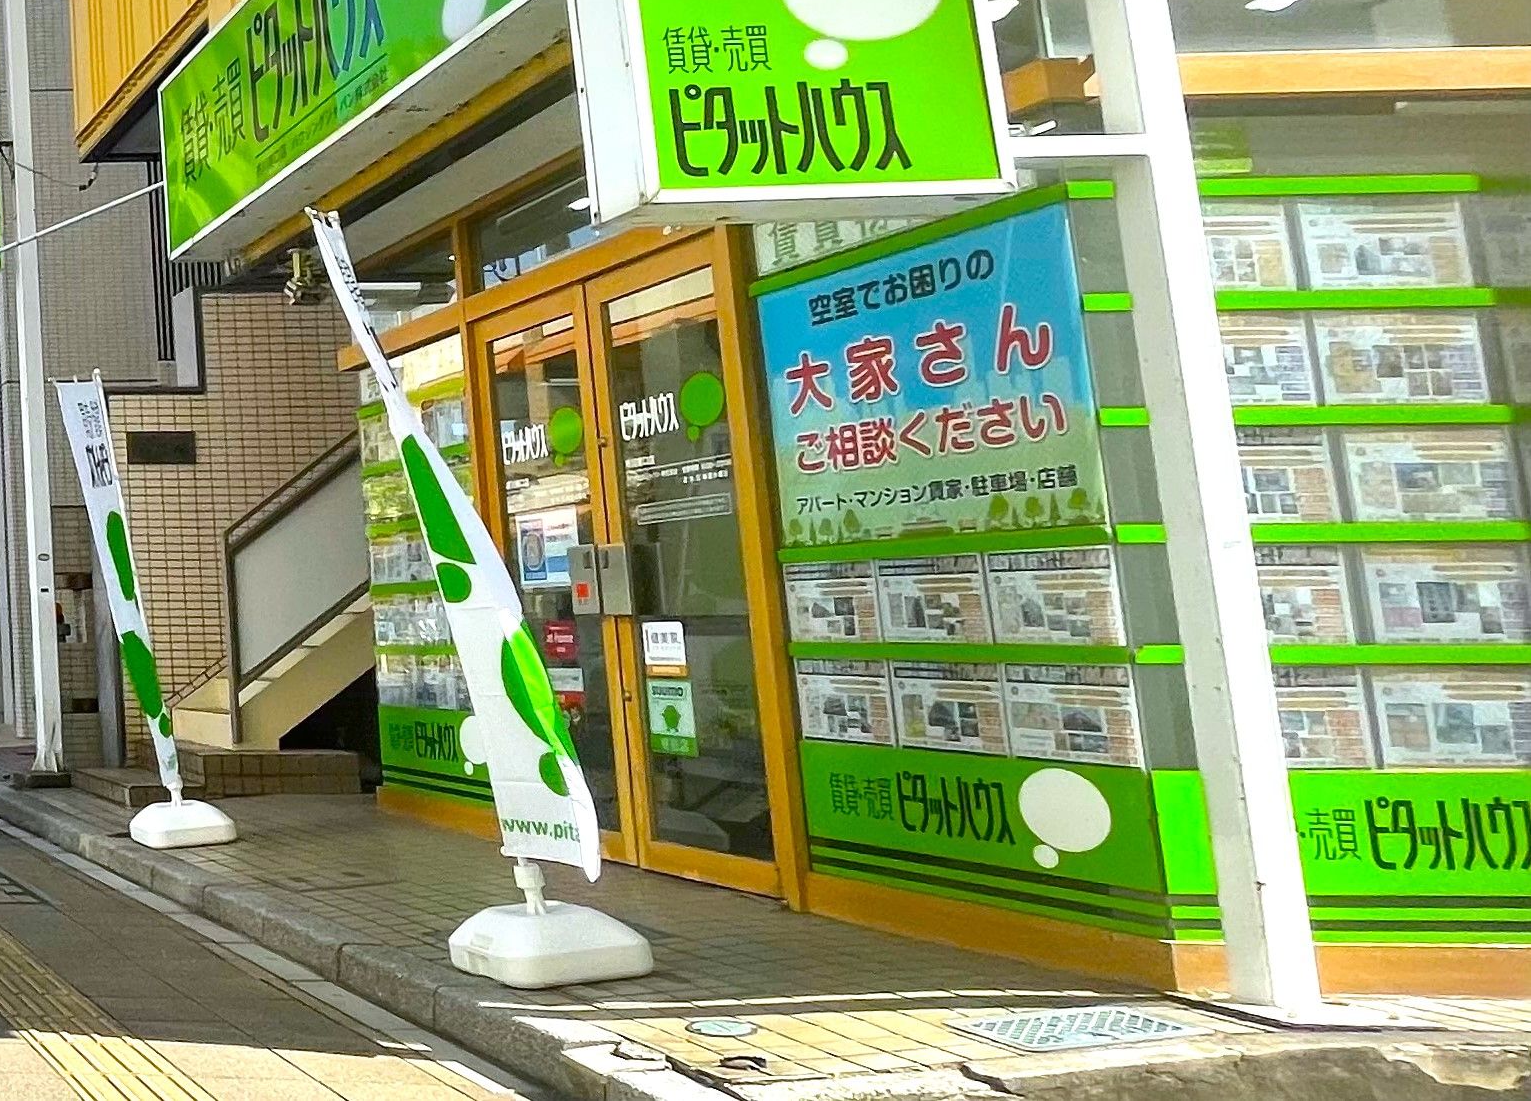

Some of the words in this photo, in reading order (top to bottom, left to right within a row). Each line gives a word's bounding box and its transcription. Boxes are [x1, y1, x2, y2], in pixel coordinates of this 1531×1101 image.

[662, 25, 772, 74] 賃貸・売買
[669, 78, 912, 177] ピタットハウス
[809, 249, 995, 326] 空室でお困りの
[785, 303, 1052, 416] 大家さん
[620, 393, 680, 441] ピタットハウス
[795, 394, 1068, 473] ご相談ください
[896, 771, 1016, 845] ピタットハウス
